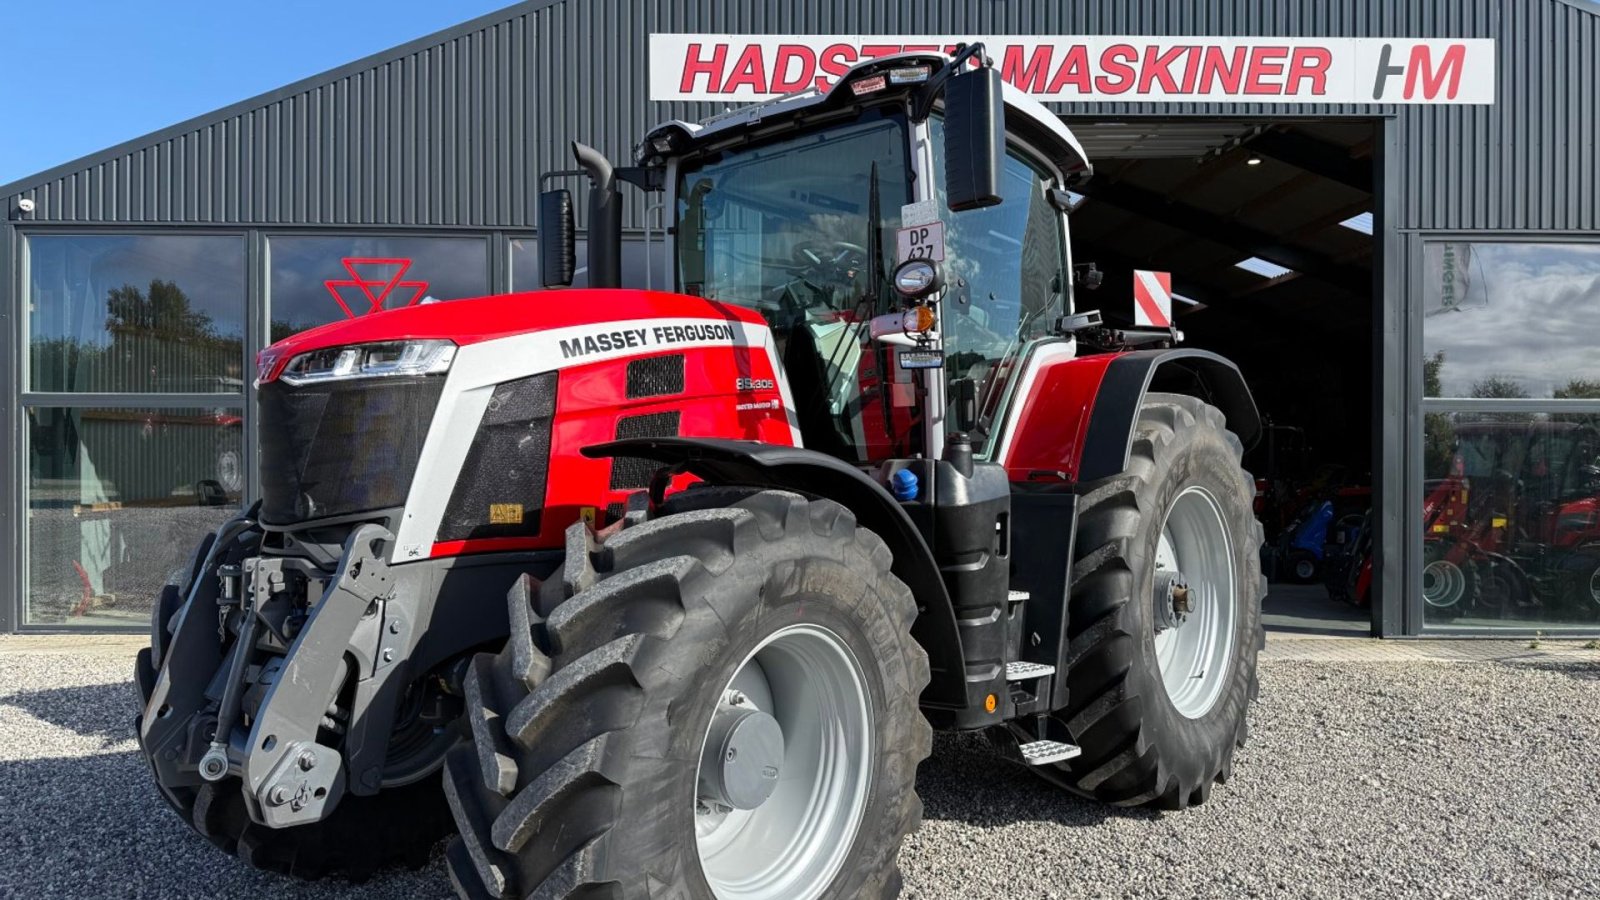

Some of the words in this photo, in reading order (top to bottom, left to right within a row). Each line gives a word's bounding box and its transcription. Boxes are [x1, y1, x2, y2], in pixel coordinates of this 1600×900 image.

[679, 43, 982, 94] HADS
[1000, 43, 1333, 96] MASKINER
[1372, 44, 1466, 99] HM
[910, 228, 929, 246] DP
[559, 328, 647, 359] MASSEY
[652, 325, 736, 344] FERGUSON
